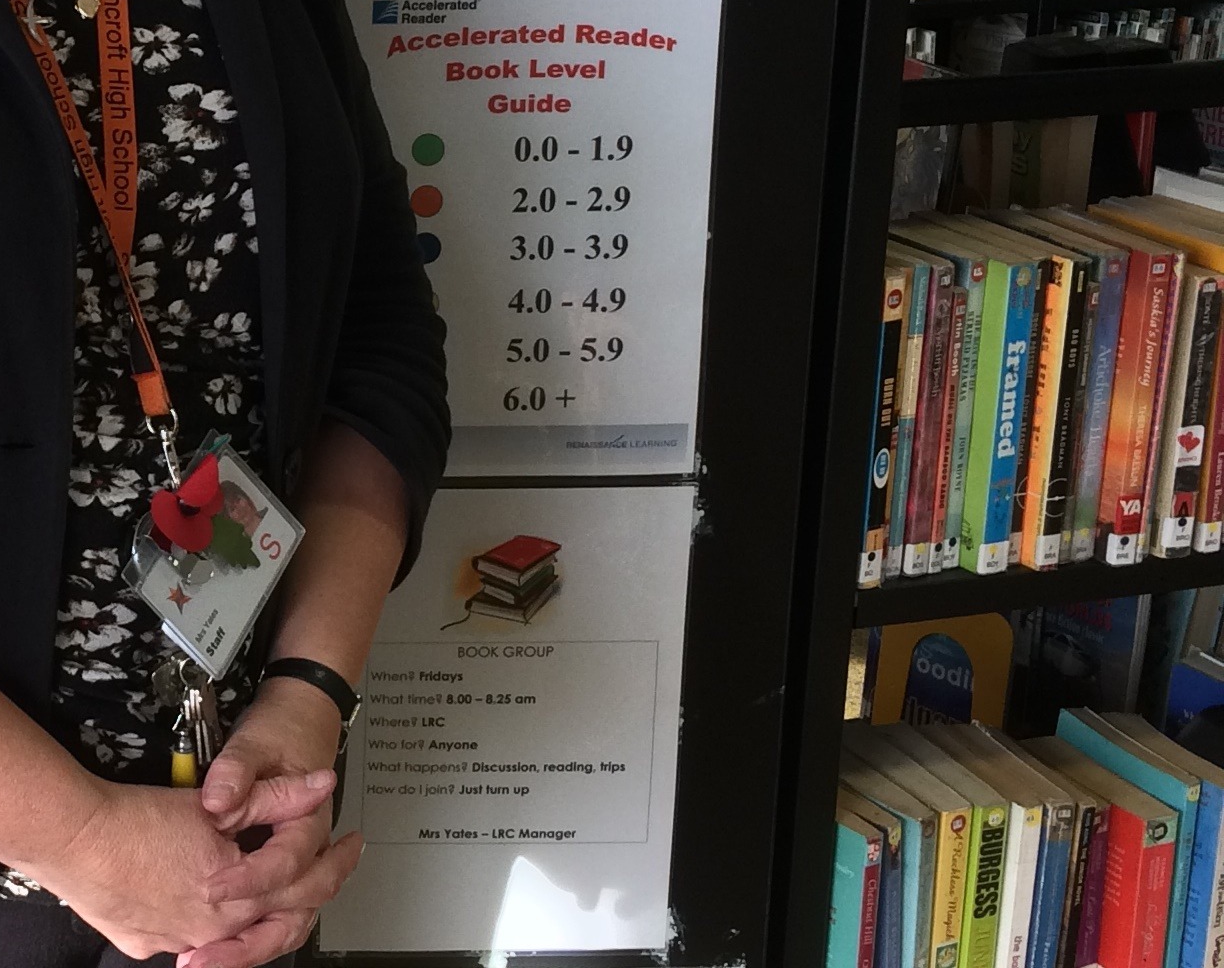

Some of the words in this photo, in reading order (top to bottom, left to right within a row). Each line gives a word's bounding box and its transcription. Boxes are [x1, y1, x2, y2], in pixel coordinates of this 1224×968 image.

[401, 12, 447, 25] Reader
[387, 24, 565, 58] Accelerated
[575, 24, 678, 53] Reader
[446, 60, 520, 82] Book
[528, 59, 606, 79] Level
[106, 67, 131, 132] High
[487, 94, 572, 114] Guide
[514, 136, 558, 162] 0.0
[590, 135, 633, 162] 1.9
[111, 129, 134, 212] School
[511, 187, 556, 213] 2.0
[585, 186, 632, 212] 2.9
[509, 235, 555, 261] 3.0
[584, 233, 629, 260] 3.9
[507, 287, 552, 314] 4.0
[581, 287, 626, 314] 4.9
[1145, 286, 1166, 340] Saskia's
[505, 337, 550, 363] 5.0
[579, 336, 624, 362] 5.9
[950, 342, 962, 378] Booth
[1136, 338, 1159, 388] Journey
[1087, 343, 1115, 420] Artichoke
[502, 385, 546, 412] 6.0
[555, 389, 576, 409] +
[998, 340, 1026, 460] framed
[628, 438, 678, 449] LEARNING
[1118, 496, 1142, 518] YA
[206, 626, 225, 657] Staff
[457, 645, 499, 659] BOOK
[503, 645, 554, 659] GROUP
[370, 670, 416, 682] When?
[418, 671, 464, 685] Fridays
[370, 693, 405, 705] What
[407, 692, 443, 705] time?
[446, 693, 473, 705] 8.00
[485, 693, 512, 705] 8.25
[515, 695, 536, 705] am
[369, 716, 418, 728] Where?
[421, 716, 445, 728] LRC
[368, 739, 398, 750] Who
[399, 738, 425, 751] for?
[428, 739, 478, 752] Anyone
[367, 761, 402, 773] What
[404, 761, 468, 775] happens?
[471, 761, 541, 775] Discussion,
[543, 761, 597, 775] reading,
[599, 761, 626, 775] trips
[366, 784, 395, 796] How
[397, 784, 416, 796] do
[423, 784, 455, 798] join?
[458, 784, 483, 796] Just
[485, 784, 511, 796] turn
[513, 786, 530, 798] up
[418, 828, 440, 839] Mrs
[444, 828, 478, 839] Yates
[492, 828, 516, 839] LRC
[518, 828, 577, 841] Manager
[973, 826, 1004, 919] BURGESS
